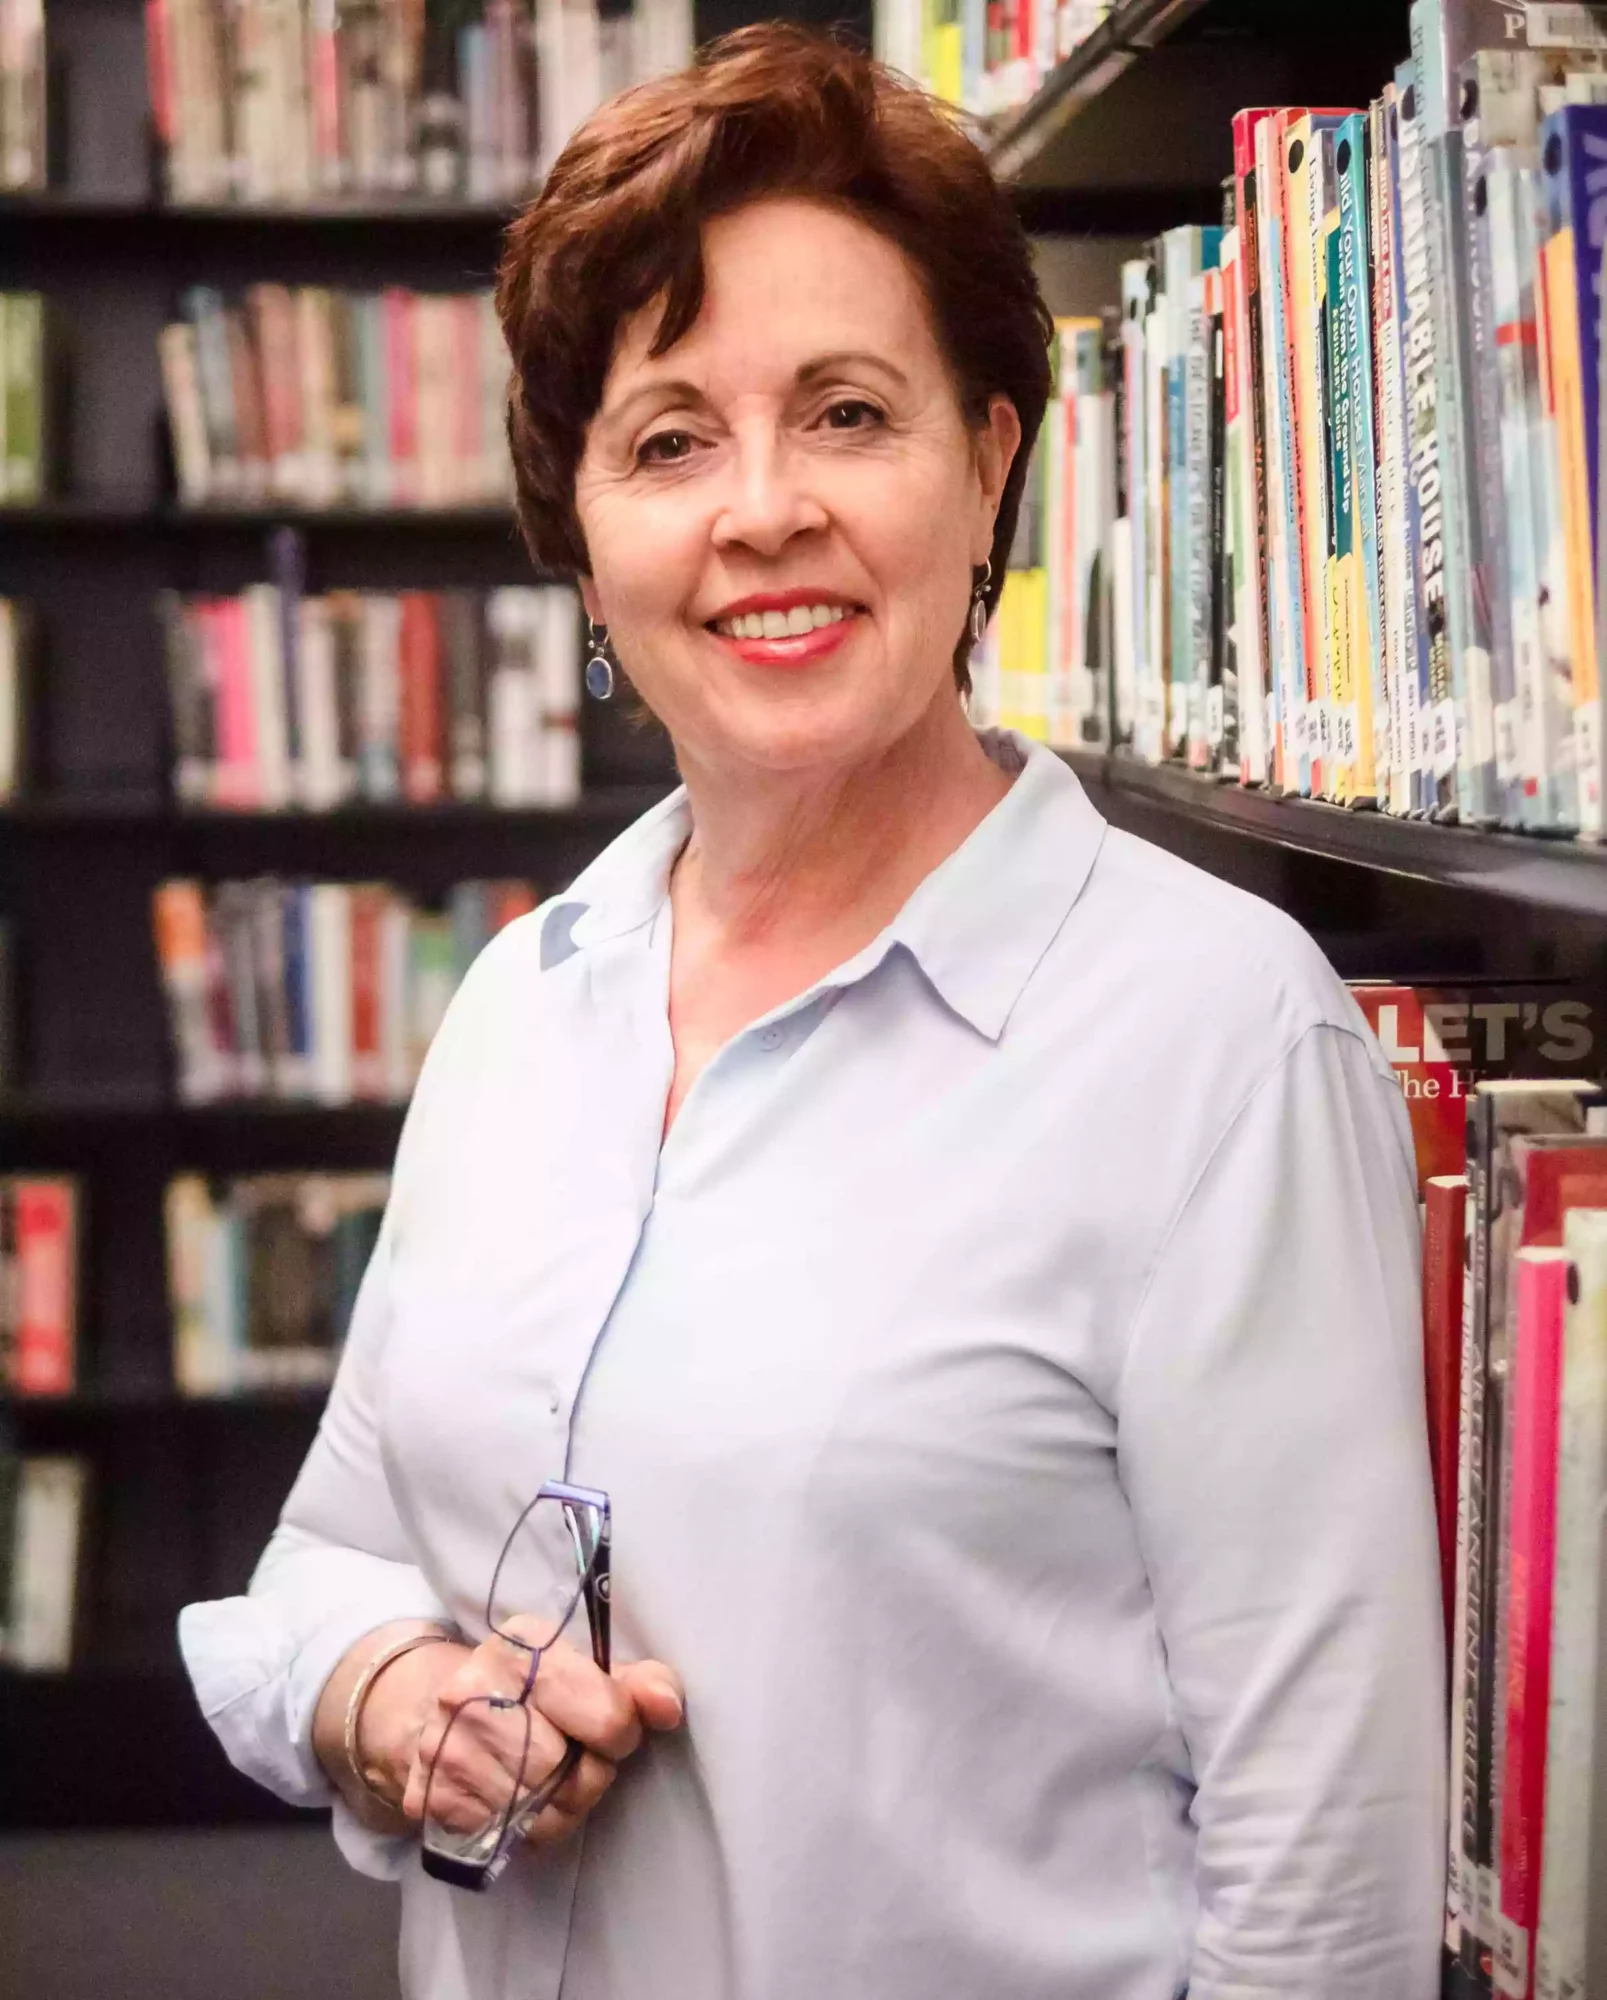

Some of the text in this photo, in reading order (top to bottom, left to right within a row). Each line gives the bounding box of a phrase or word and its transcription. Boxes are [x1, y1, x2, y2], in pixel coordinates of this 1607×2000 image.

[1309, 156, 1317, 226] Living
[1379, 157, 1388, 211] BUILD
[1380, 213, 1389, 256] LIKE
[1381, 259, 1390, 271] A
[1397, 118, 1437, 412] USTAINABLE
[1333, 321, 1341, 400] BUILDER'S
[1340, 303, 1348, 355] from
[1340, 171, 1372, 541] uild Your Own House Manual
[1341, 357, 1349, 394] the
[1341, 397, 1350, 478] Ground
[1342, 480, 1351, 514] Up
[1375, 465, 1384, 551] BACKYARD
[1410, 429, 1446, 608] HOUSE
[1379, 1001, 1593, 1061] LET'S
